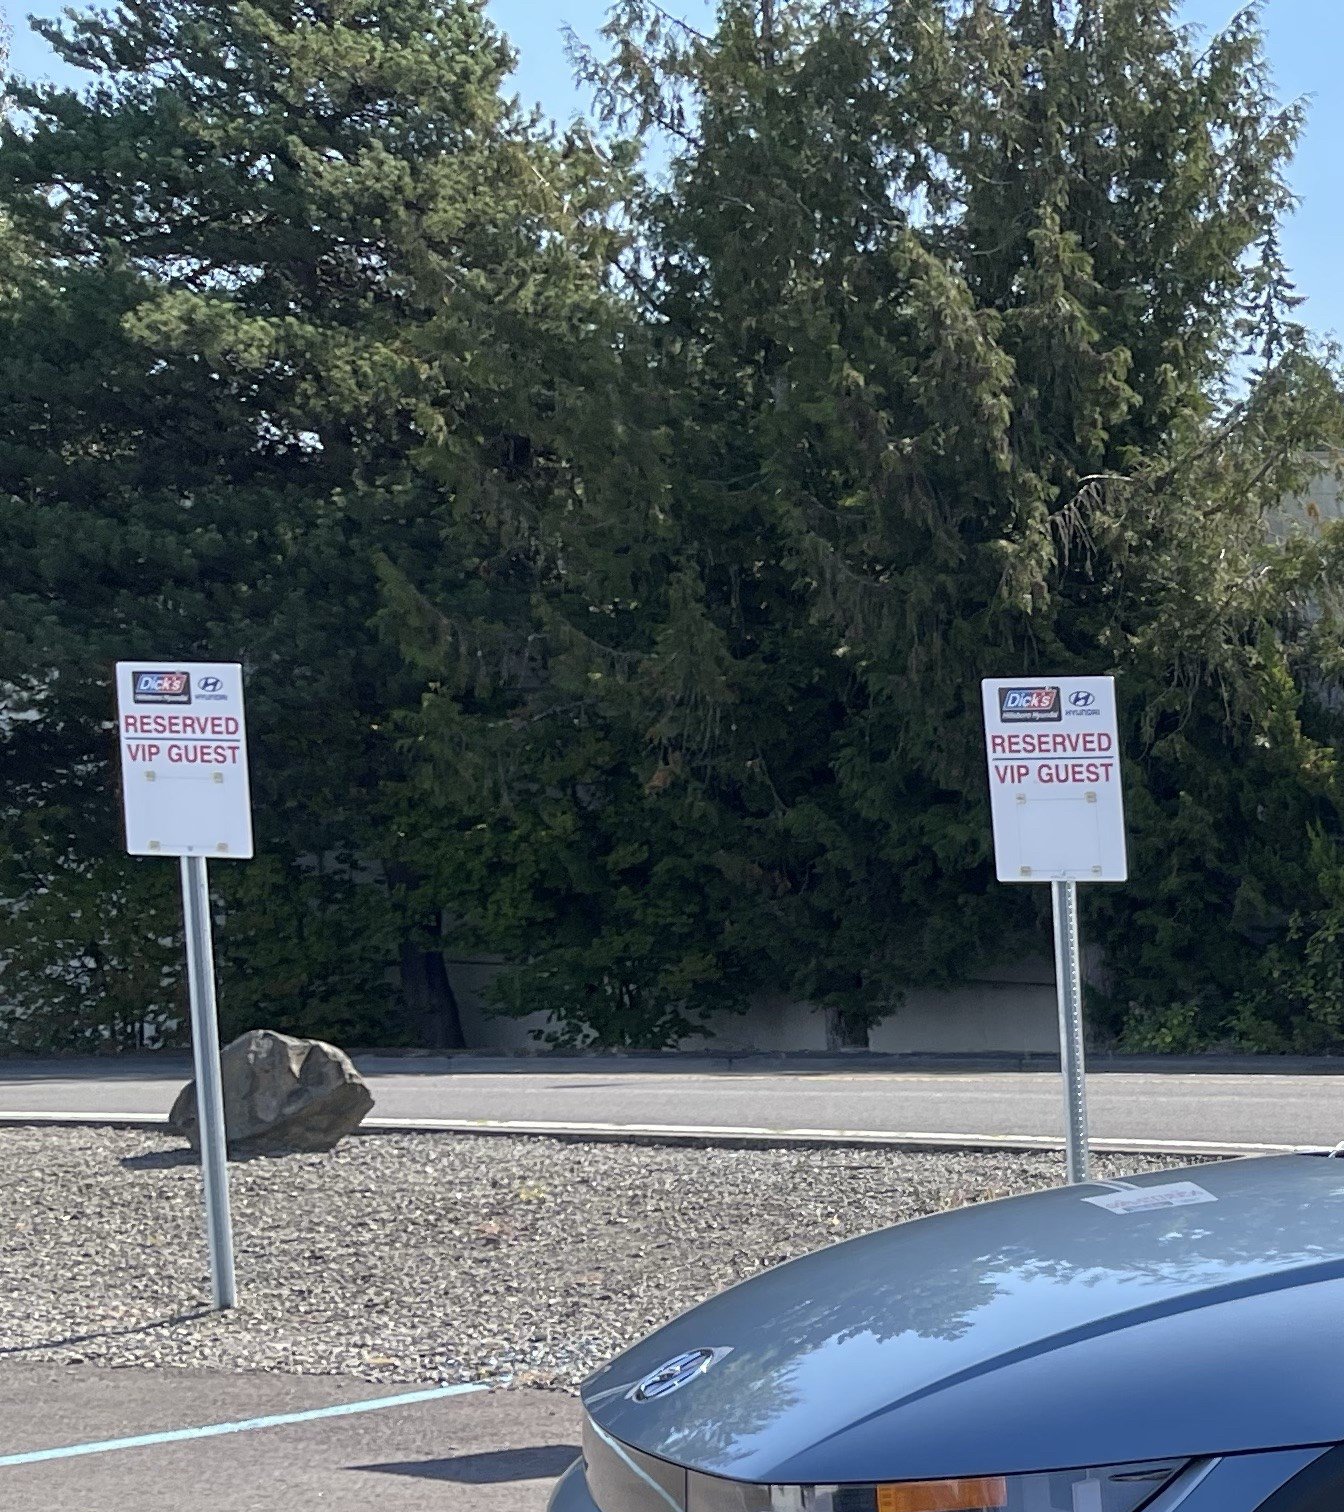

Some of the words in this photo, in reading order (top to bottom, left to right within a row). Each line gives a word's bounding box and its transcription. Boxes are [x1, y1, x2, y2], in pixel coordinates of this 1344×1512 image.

[125, 715, 239, 735] RESERVED
[991, 733, 1112, 753] RESERVED
[126, 744, 160, 762] VIP
[167, 745, 240, 764] GUEST
[995, 765, 1030, 784] VIP
[1037, 763, 1113, 784] GUEST
